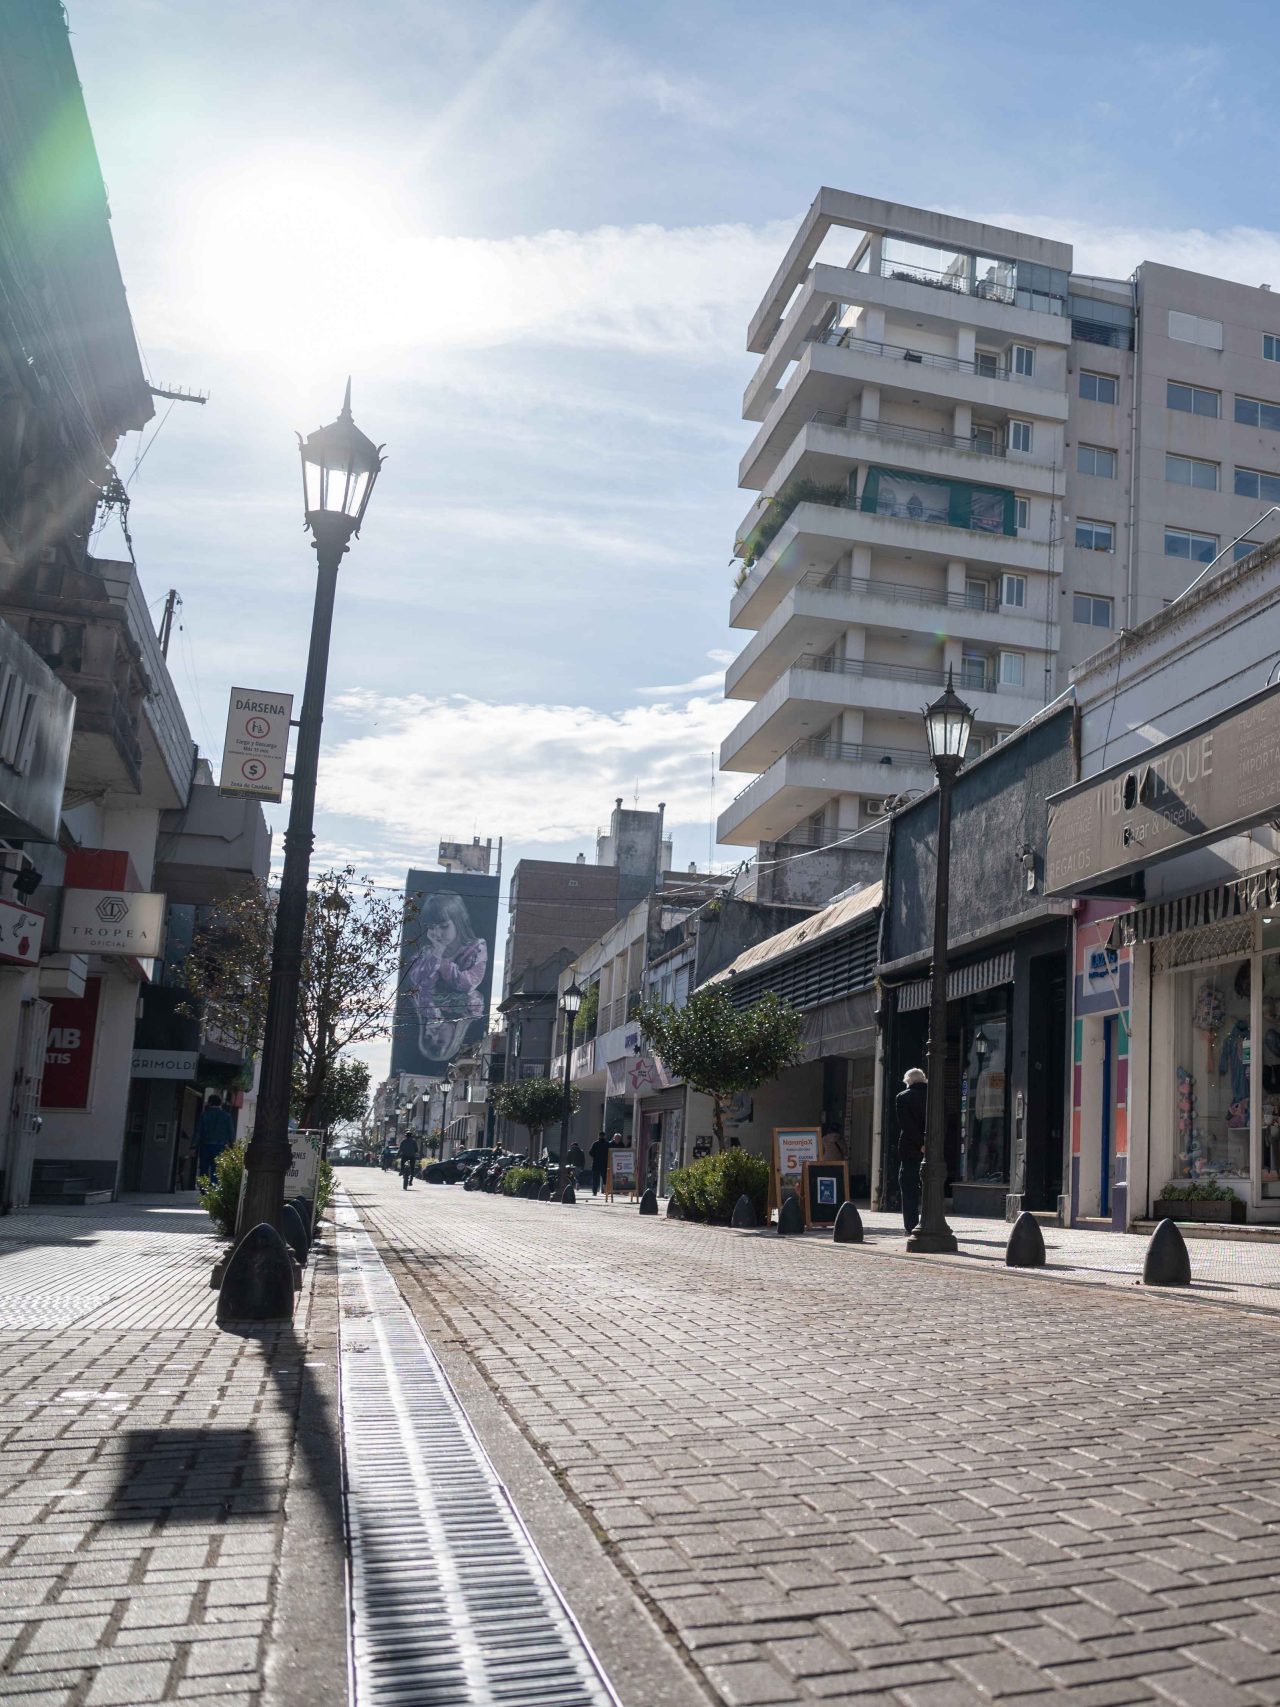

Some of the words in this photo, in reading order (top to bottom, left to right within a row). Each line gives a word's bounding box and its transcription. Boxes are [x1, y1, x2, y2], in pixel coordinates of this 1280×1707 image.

[235, 698, 286, 716] DÁRSENA
[1151, 815, 1159, 835] &
[1163, 799, 1198, 831] Diseño
[72, 926, 148, 939] TROPEA
[90, 940, 127, 948] OFICIAL
[46, 1052, 71, 1064] TIS
[132, 1059, 196, 1070] GRIMOLDI
[616, 1162, 623, 1171] 5
[787, 1154, 798, 1169] 5
